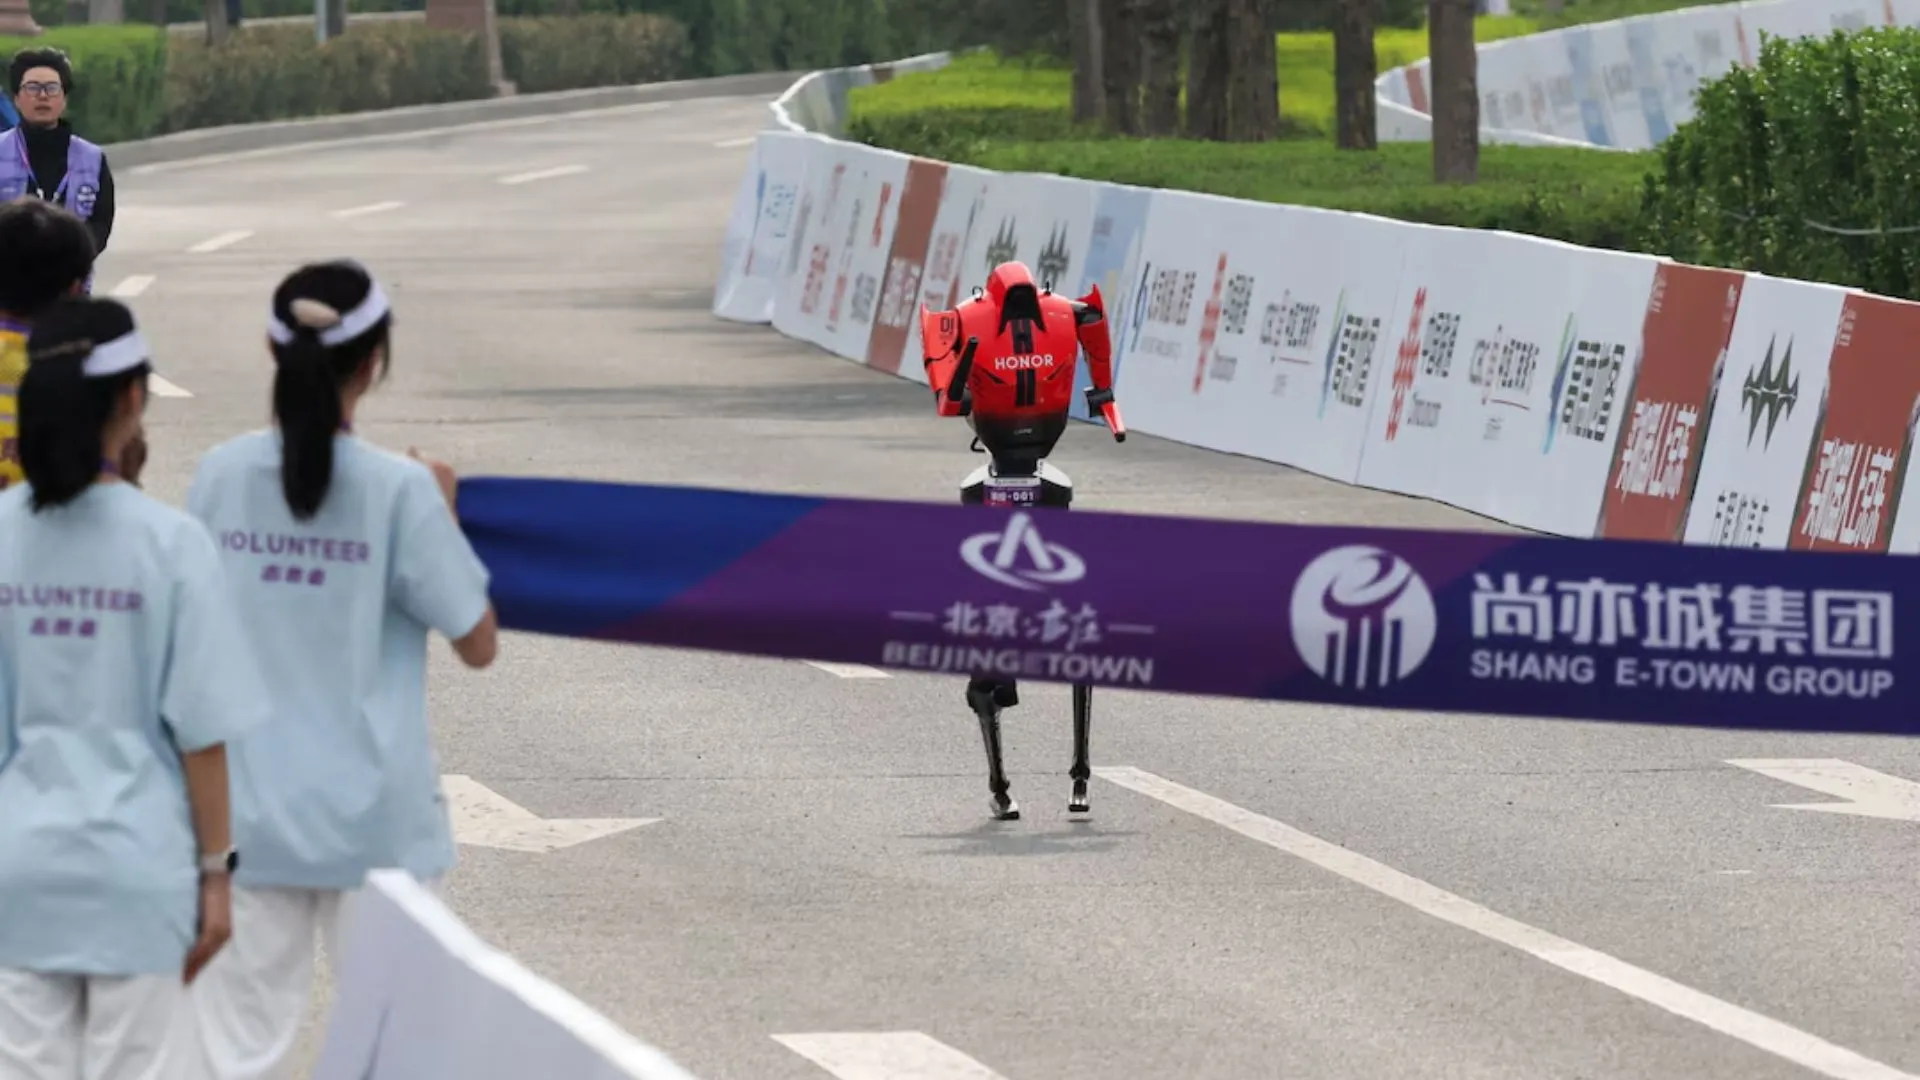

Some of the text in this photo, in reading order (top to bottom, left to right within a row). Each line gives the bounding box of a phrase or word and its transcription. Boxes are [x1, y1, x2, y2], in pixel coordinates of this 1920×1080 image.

[995, 353, 1054, 370] HONOR
[1469, 571, 1895, 659] 尚亦城集团
[1470, 650, 1895, 699] SHANG E-TOWN GROUP
